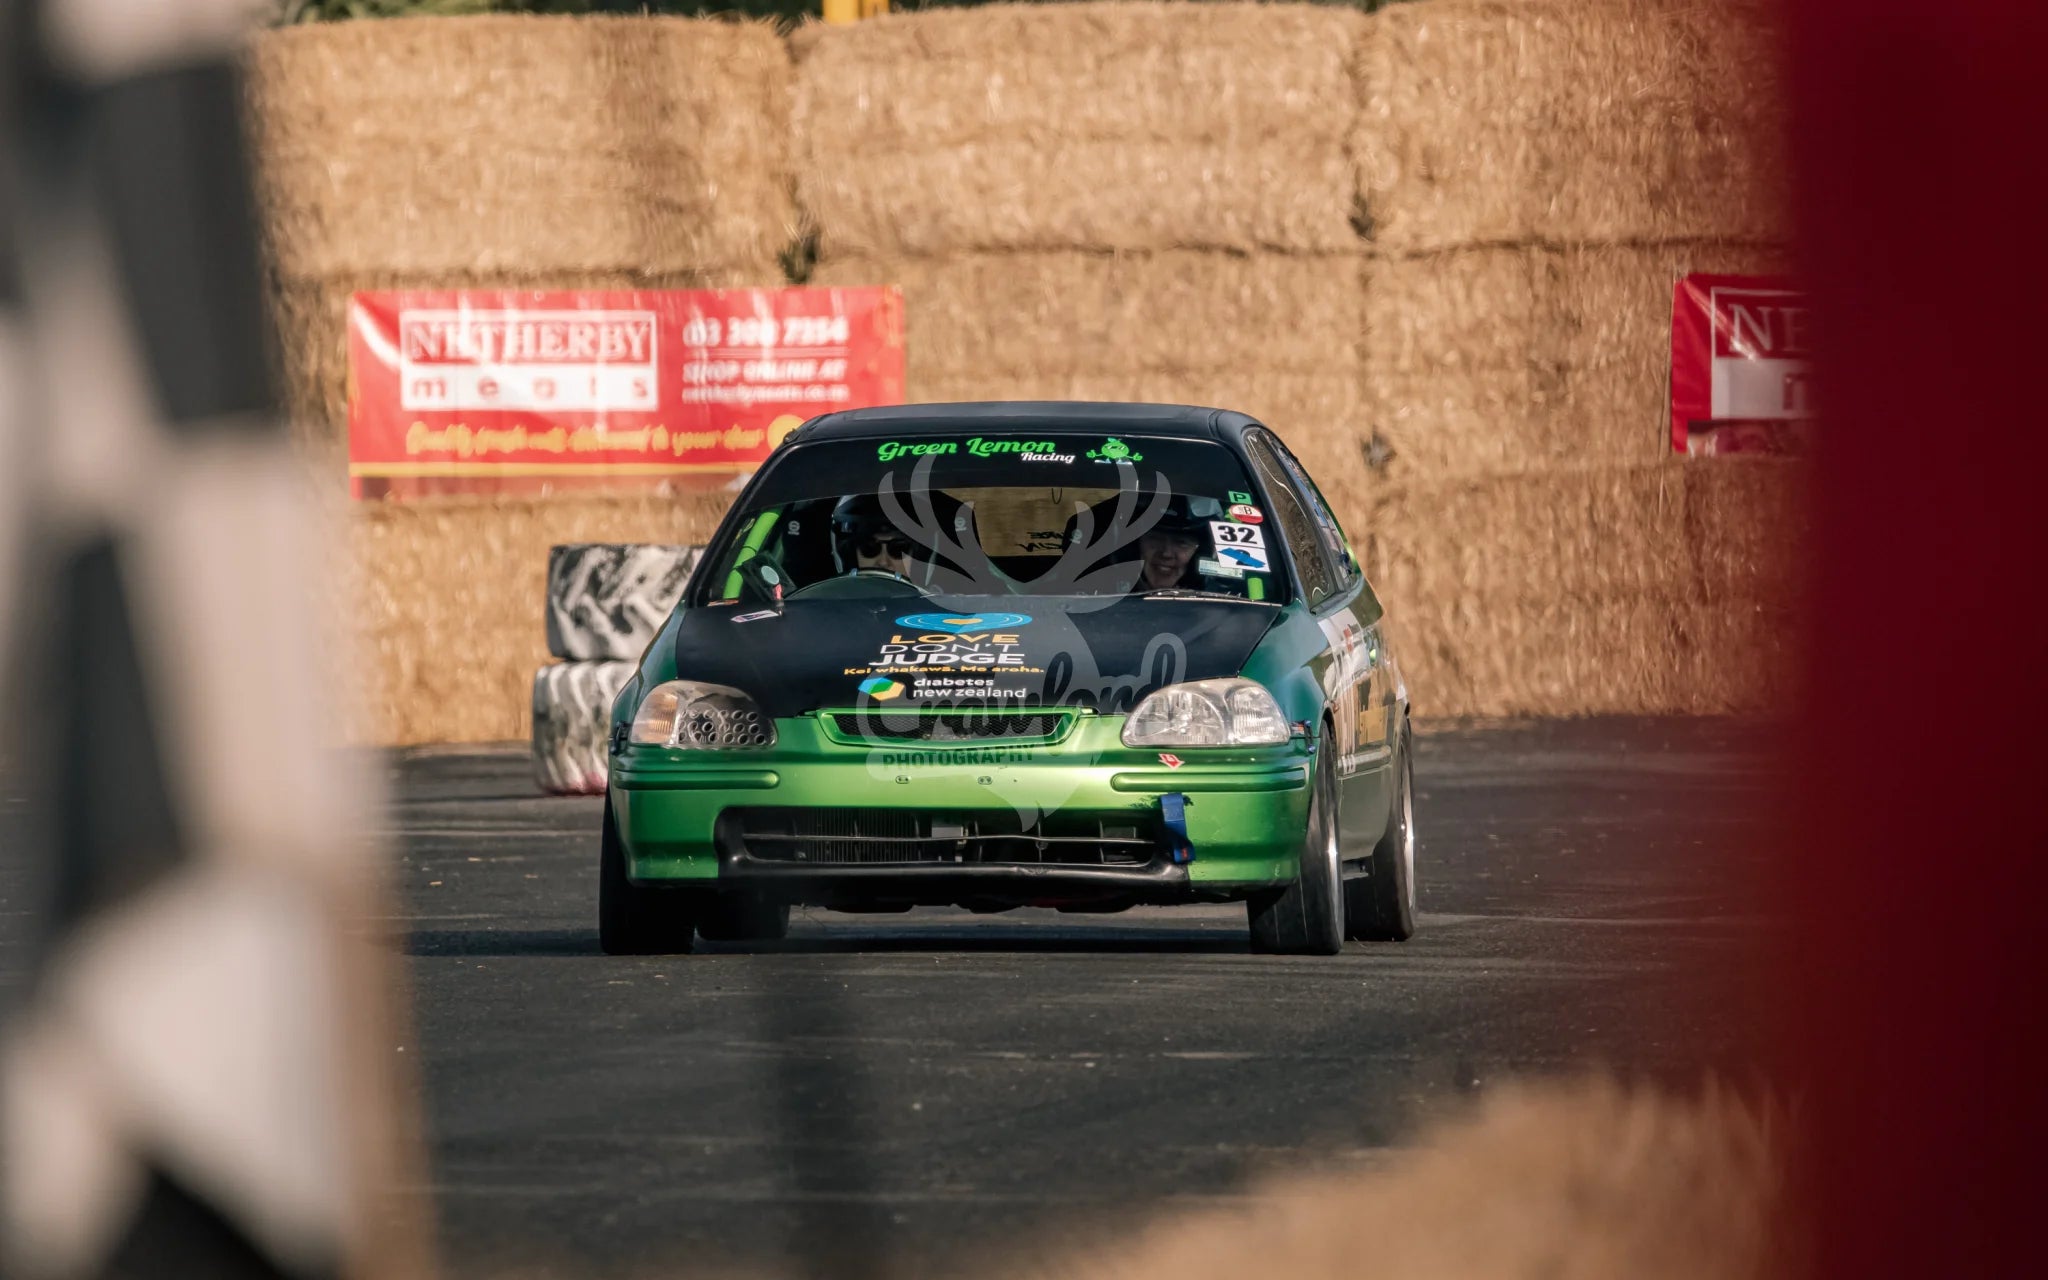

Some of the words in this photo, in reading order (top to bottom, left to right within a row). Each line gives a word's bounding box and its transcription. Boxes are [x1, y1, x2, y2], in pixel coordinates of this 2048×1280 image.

[408, 319, 649, 363] NETHERBY
[878, 441, 957, 461] Green
[966, 438, 1056, 454] Lemon
[1021, 452, 1075, 463] Racing
[1233, 493, 1246, 502] P
[1218, 525, 1258, 545] 32
[890, 634, 1020, 644] LOVE
[880, 643, 1020, 654] DON'T
[868, 653, 1026, 666] JUDGE
[914, 678, 994, 687] diabetes
[913, 689, 951, 698] new
[954, 687, 1027, 698] zealand
